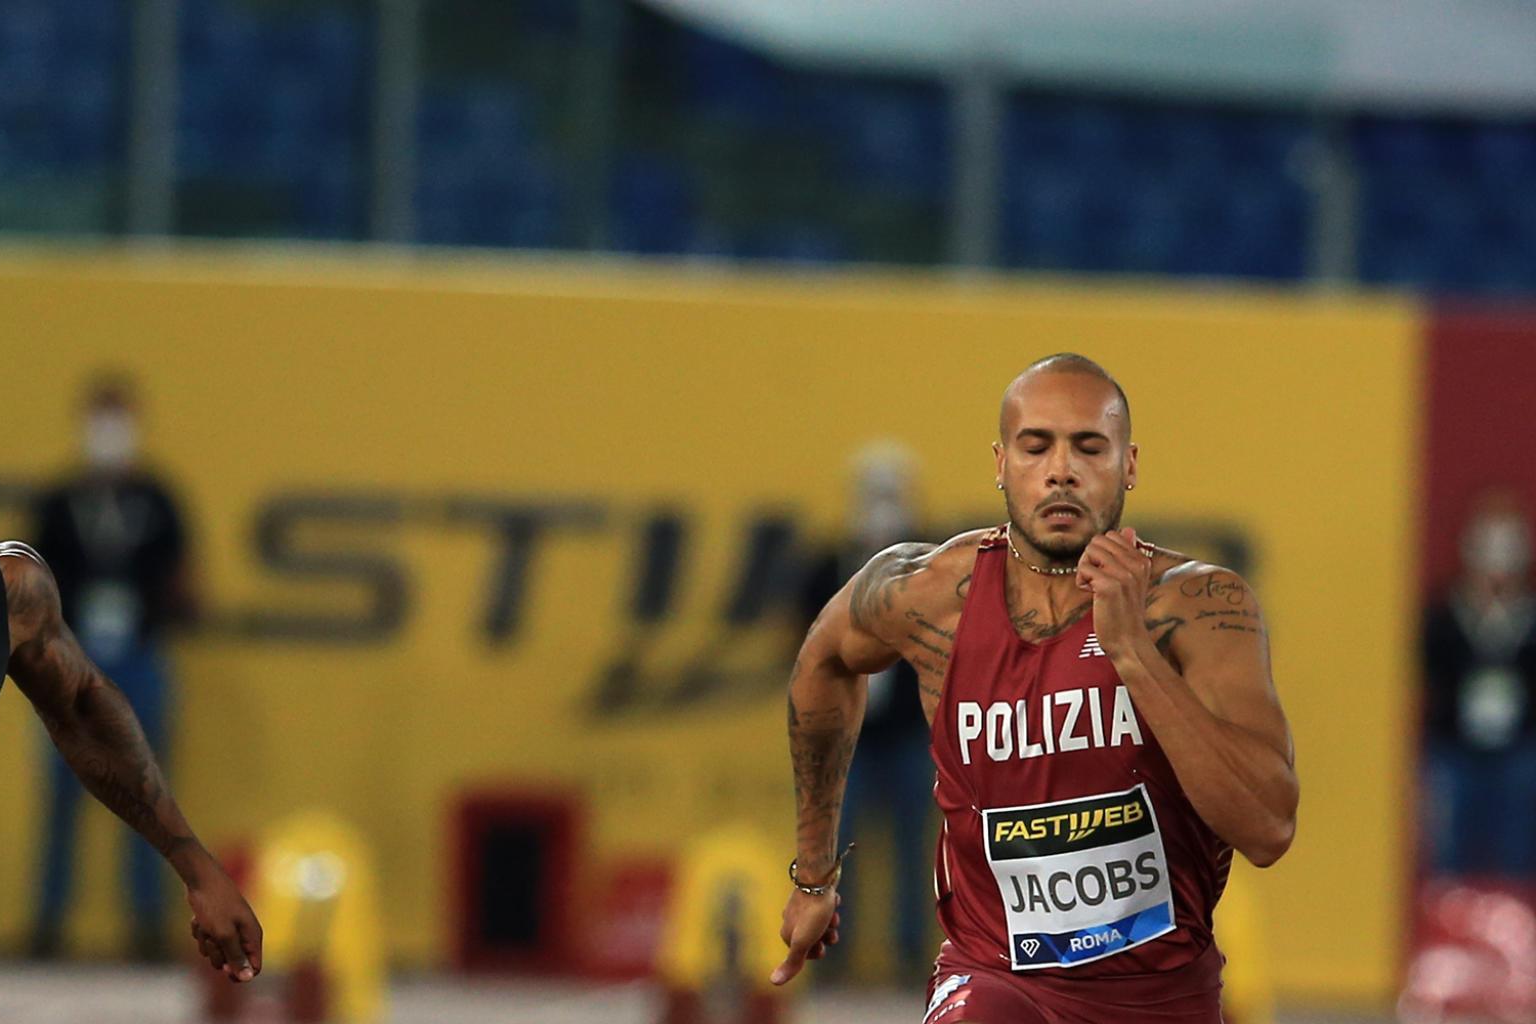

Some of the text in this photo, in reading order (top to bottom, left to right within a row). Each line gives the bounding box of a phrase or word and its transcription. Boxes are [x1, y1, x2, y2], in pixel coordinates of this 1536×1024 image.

[958, 685, 1144, 765] POLIZIA
[994, 801, 1144, 843] FASTWEB
[1010, 851, 1161, 913] JACOBS
[1070, 928, 1122, 952] ROMA
